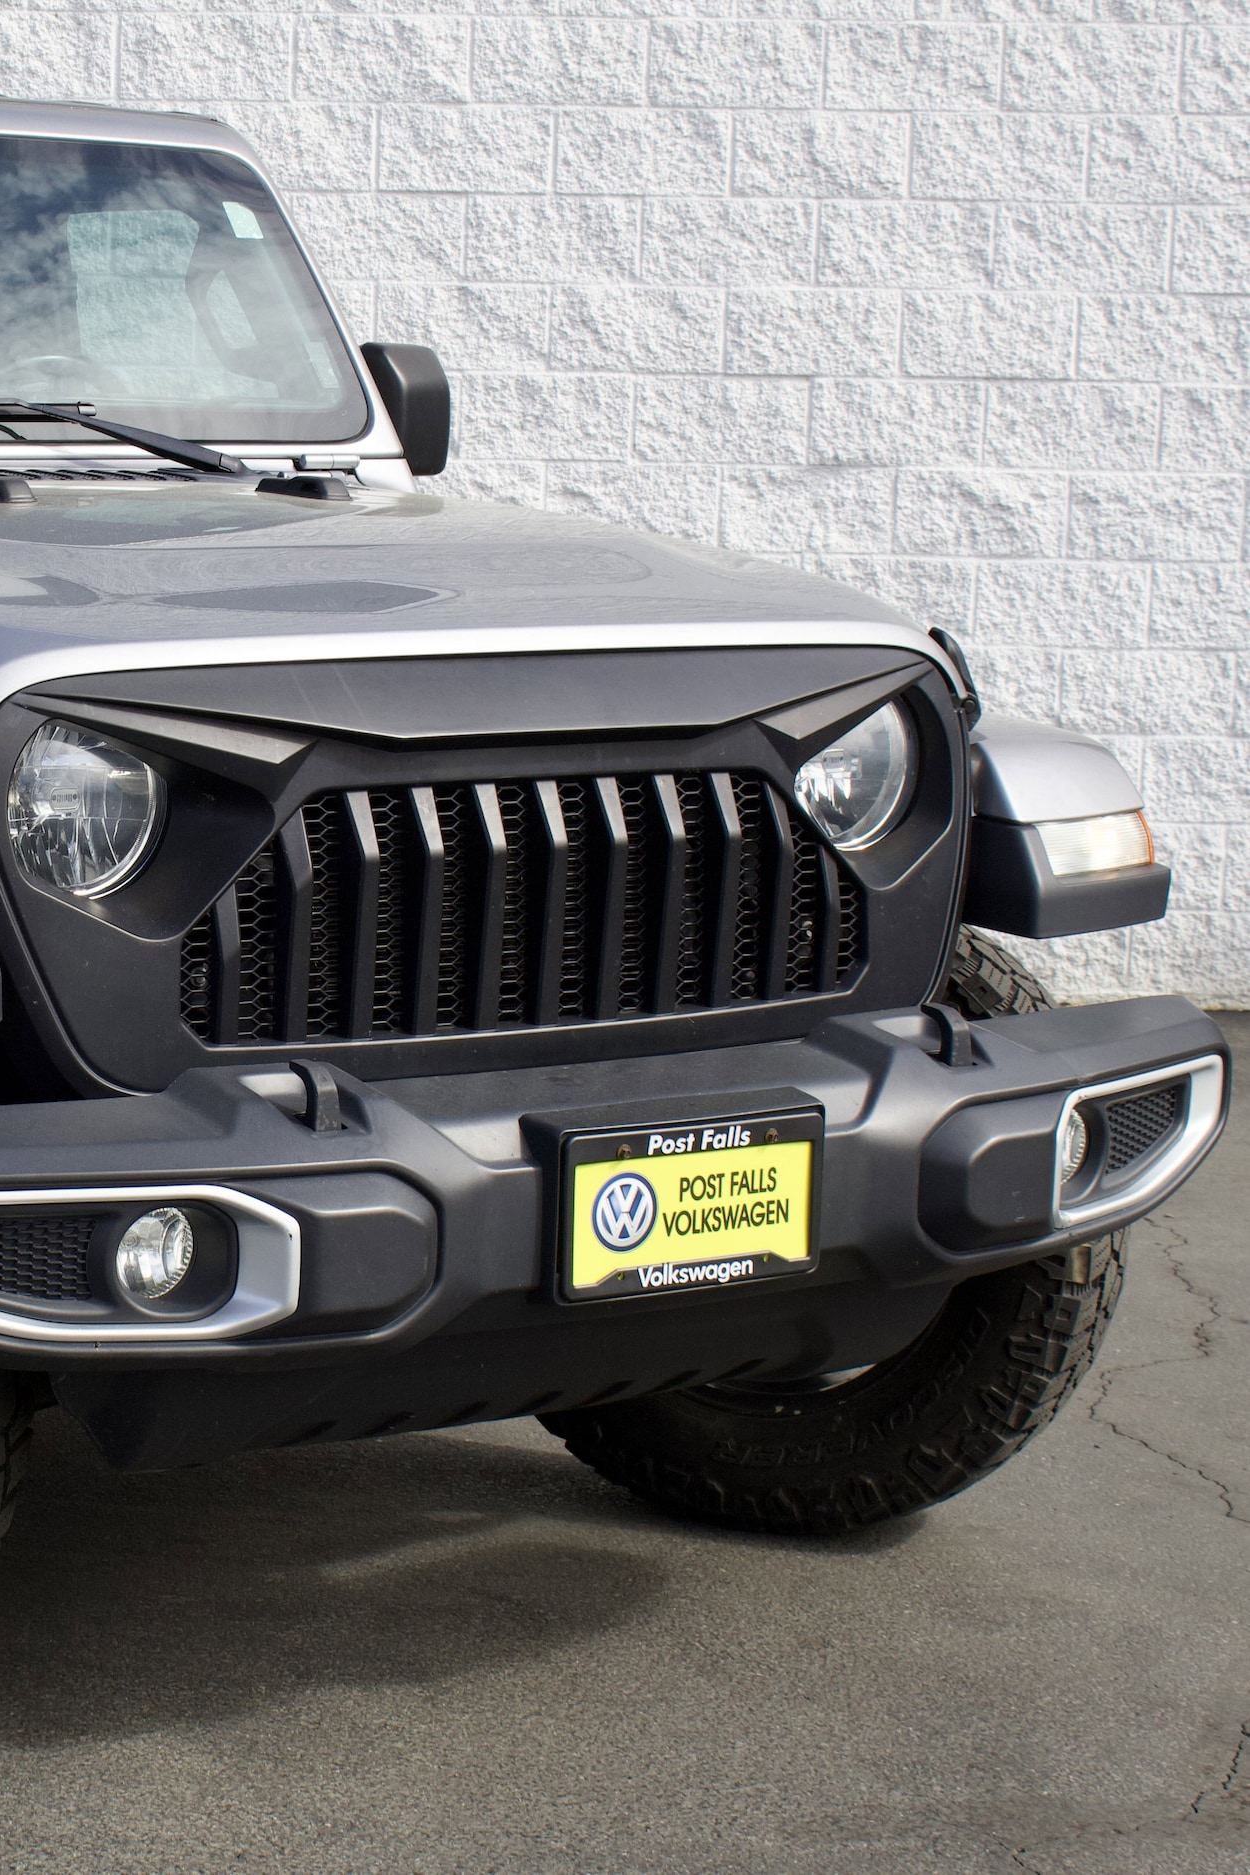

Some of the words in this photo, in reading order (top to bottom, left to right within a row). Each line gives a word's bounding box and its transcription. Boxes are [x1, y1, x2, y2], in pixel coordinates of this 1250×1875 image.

[647, 1133, 695, 1156] Post
[700, 1125, 751, 1151] Falls
[679, 1173, 725, 1202] POST
[730, 1167, 777, 1196] FALLS
[662, 1198, 789, 1237] VOLKSWAGEN
[637, 1259, 753, 1288] Volkswagen
